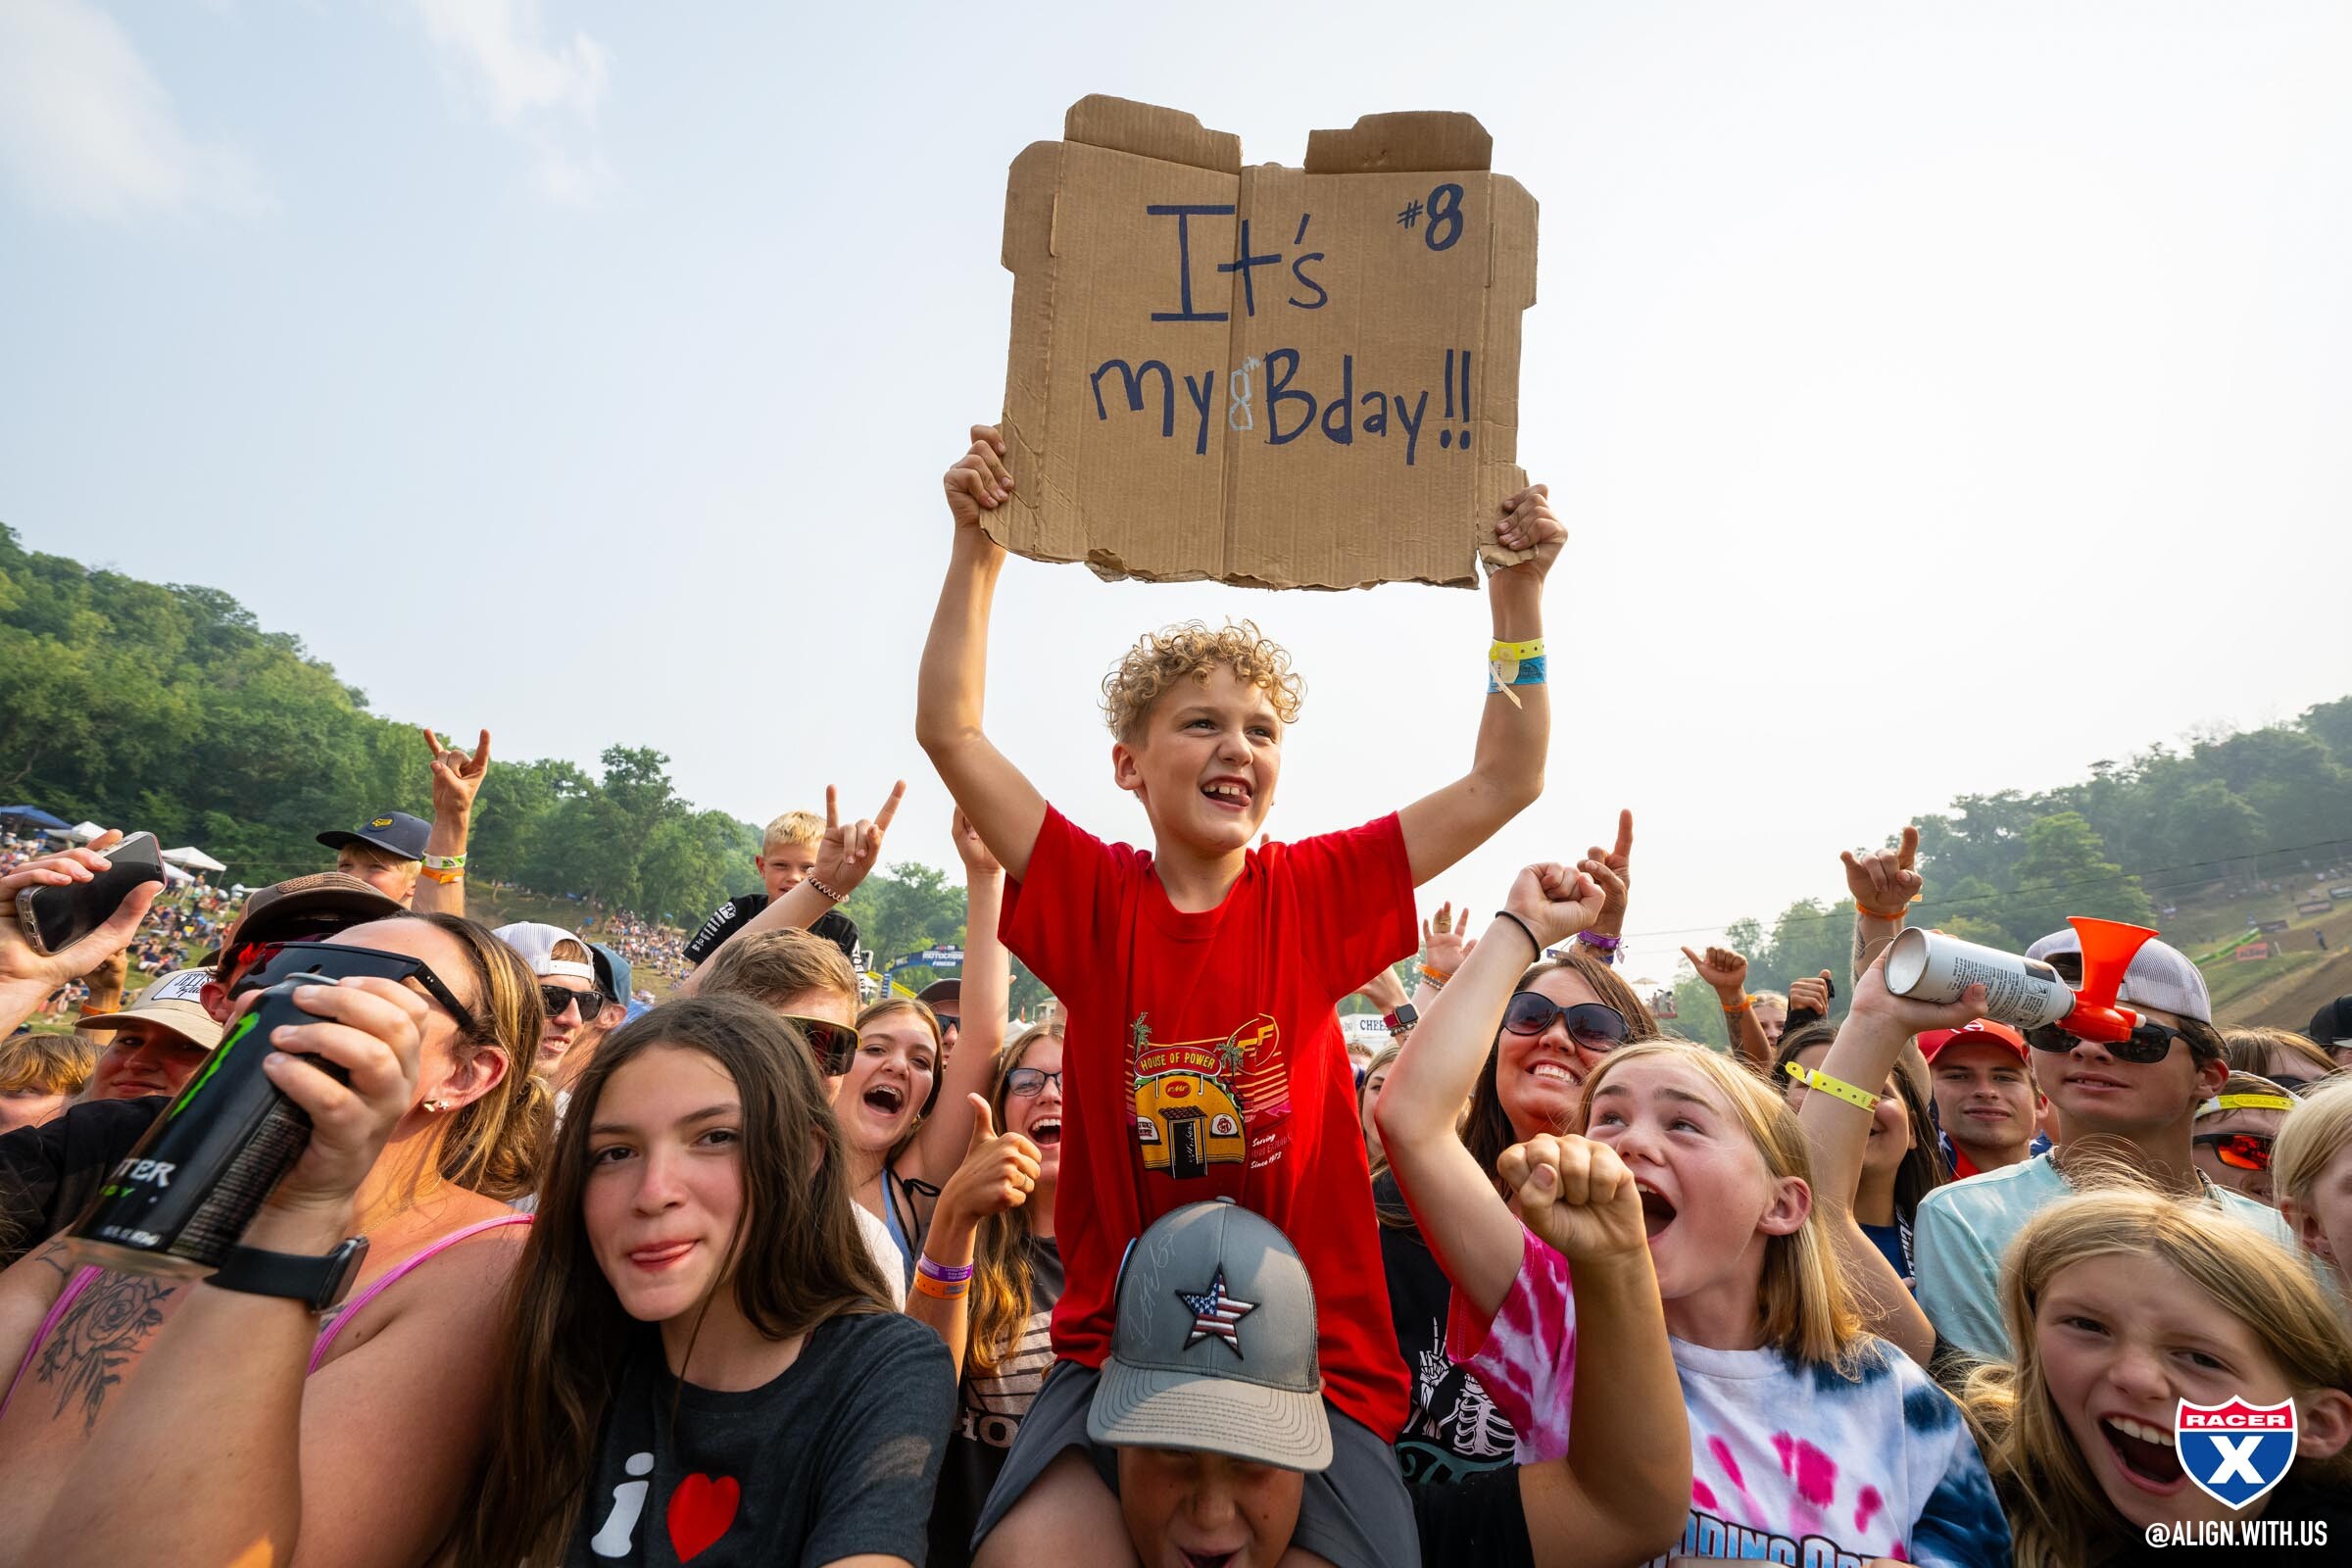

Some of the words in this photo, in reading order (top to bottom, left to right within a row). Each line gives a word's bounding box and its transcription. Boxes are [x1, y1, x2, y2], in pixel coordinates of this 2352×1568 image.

[1396, 183, 1464, 251] #8
[1147, 204, 1328, 321] It's
[1262, 348, 1471, 466] Bday!!
[1141, 1054, 1166, 1071] HOUSE
[1170, 1053, 1180, 1064] OF
[1184, 1052, 1215, 1070] POWER
[1251, 1133, 1276, 1147] Serving
[591, 1451, 654, 1558] i
